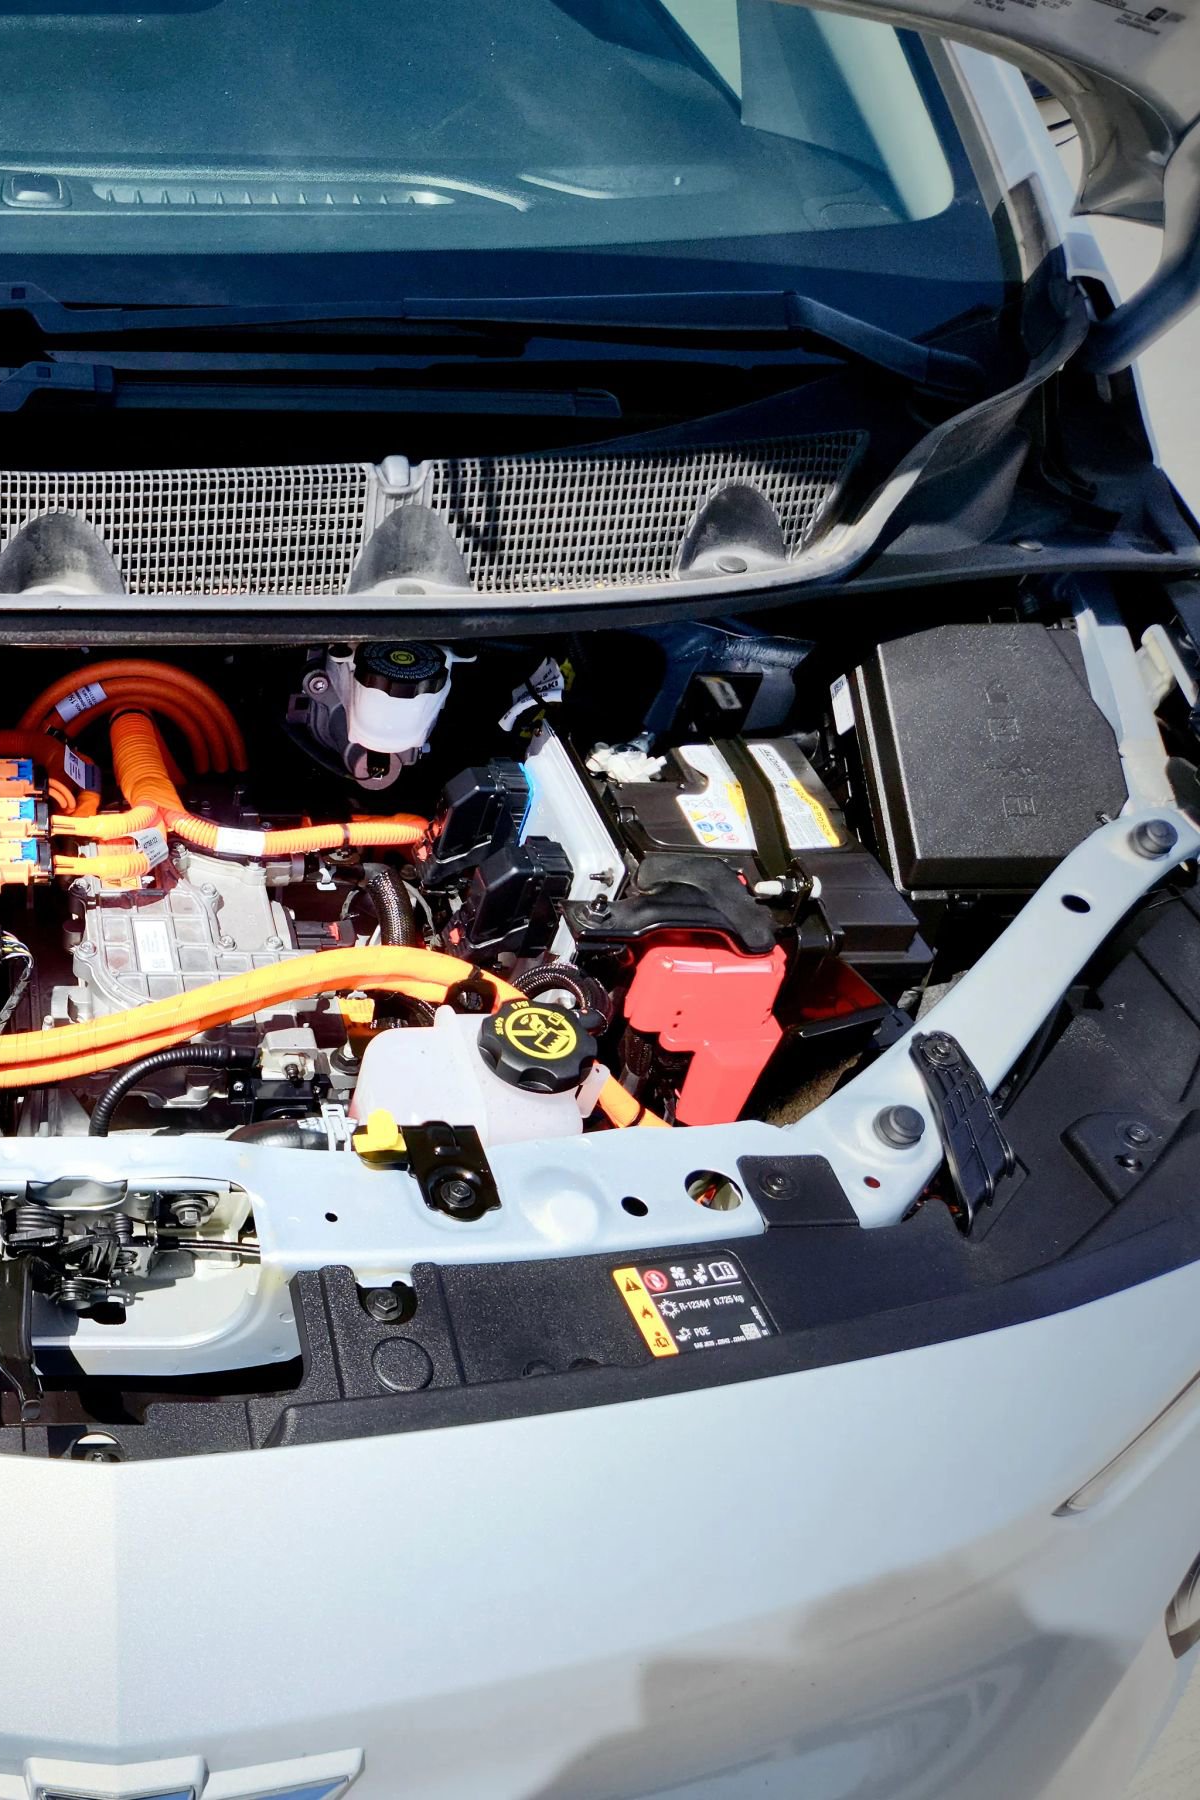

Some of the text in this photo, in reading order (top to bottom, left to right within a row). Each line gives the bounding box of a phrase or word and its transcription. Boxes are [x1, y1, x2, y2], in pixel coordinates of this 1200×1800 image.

[675, 1279, 692, 1288] AUTO
[714, 1295, 734, 1306] 0.725
[734, 1295, 744, 1303] kg
[693, 1326, 711, 1337] POE
